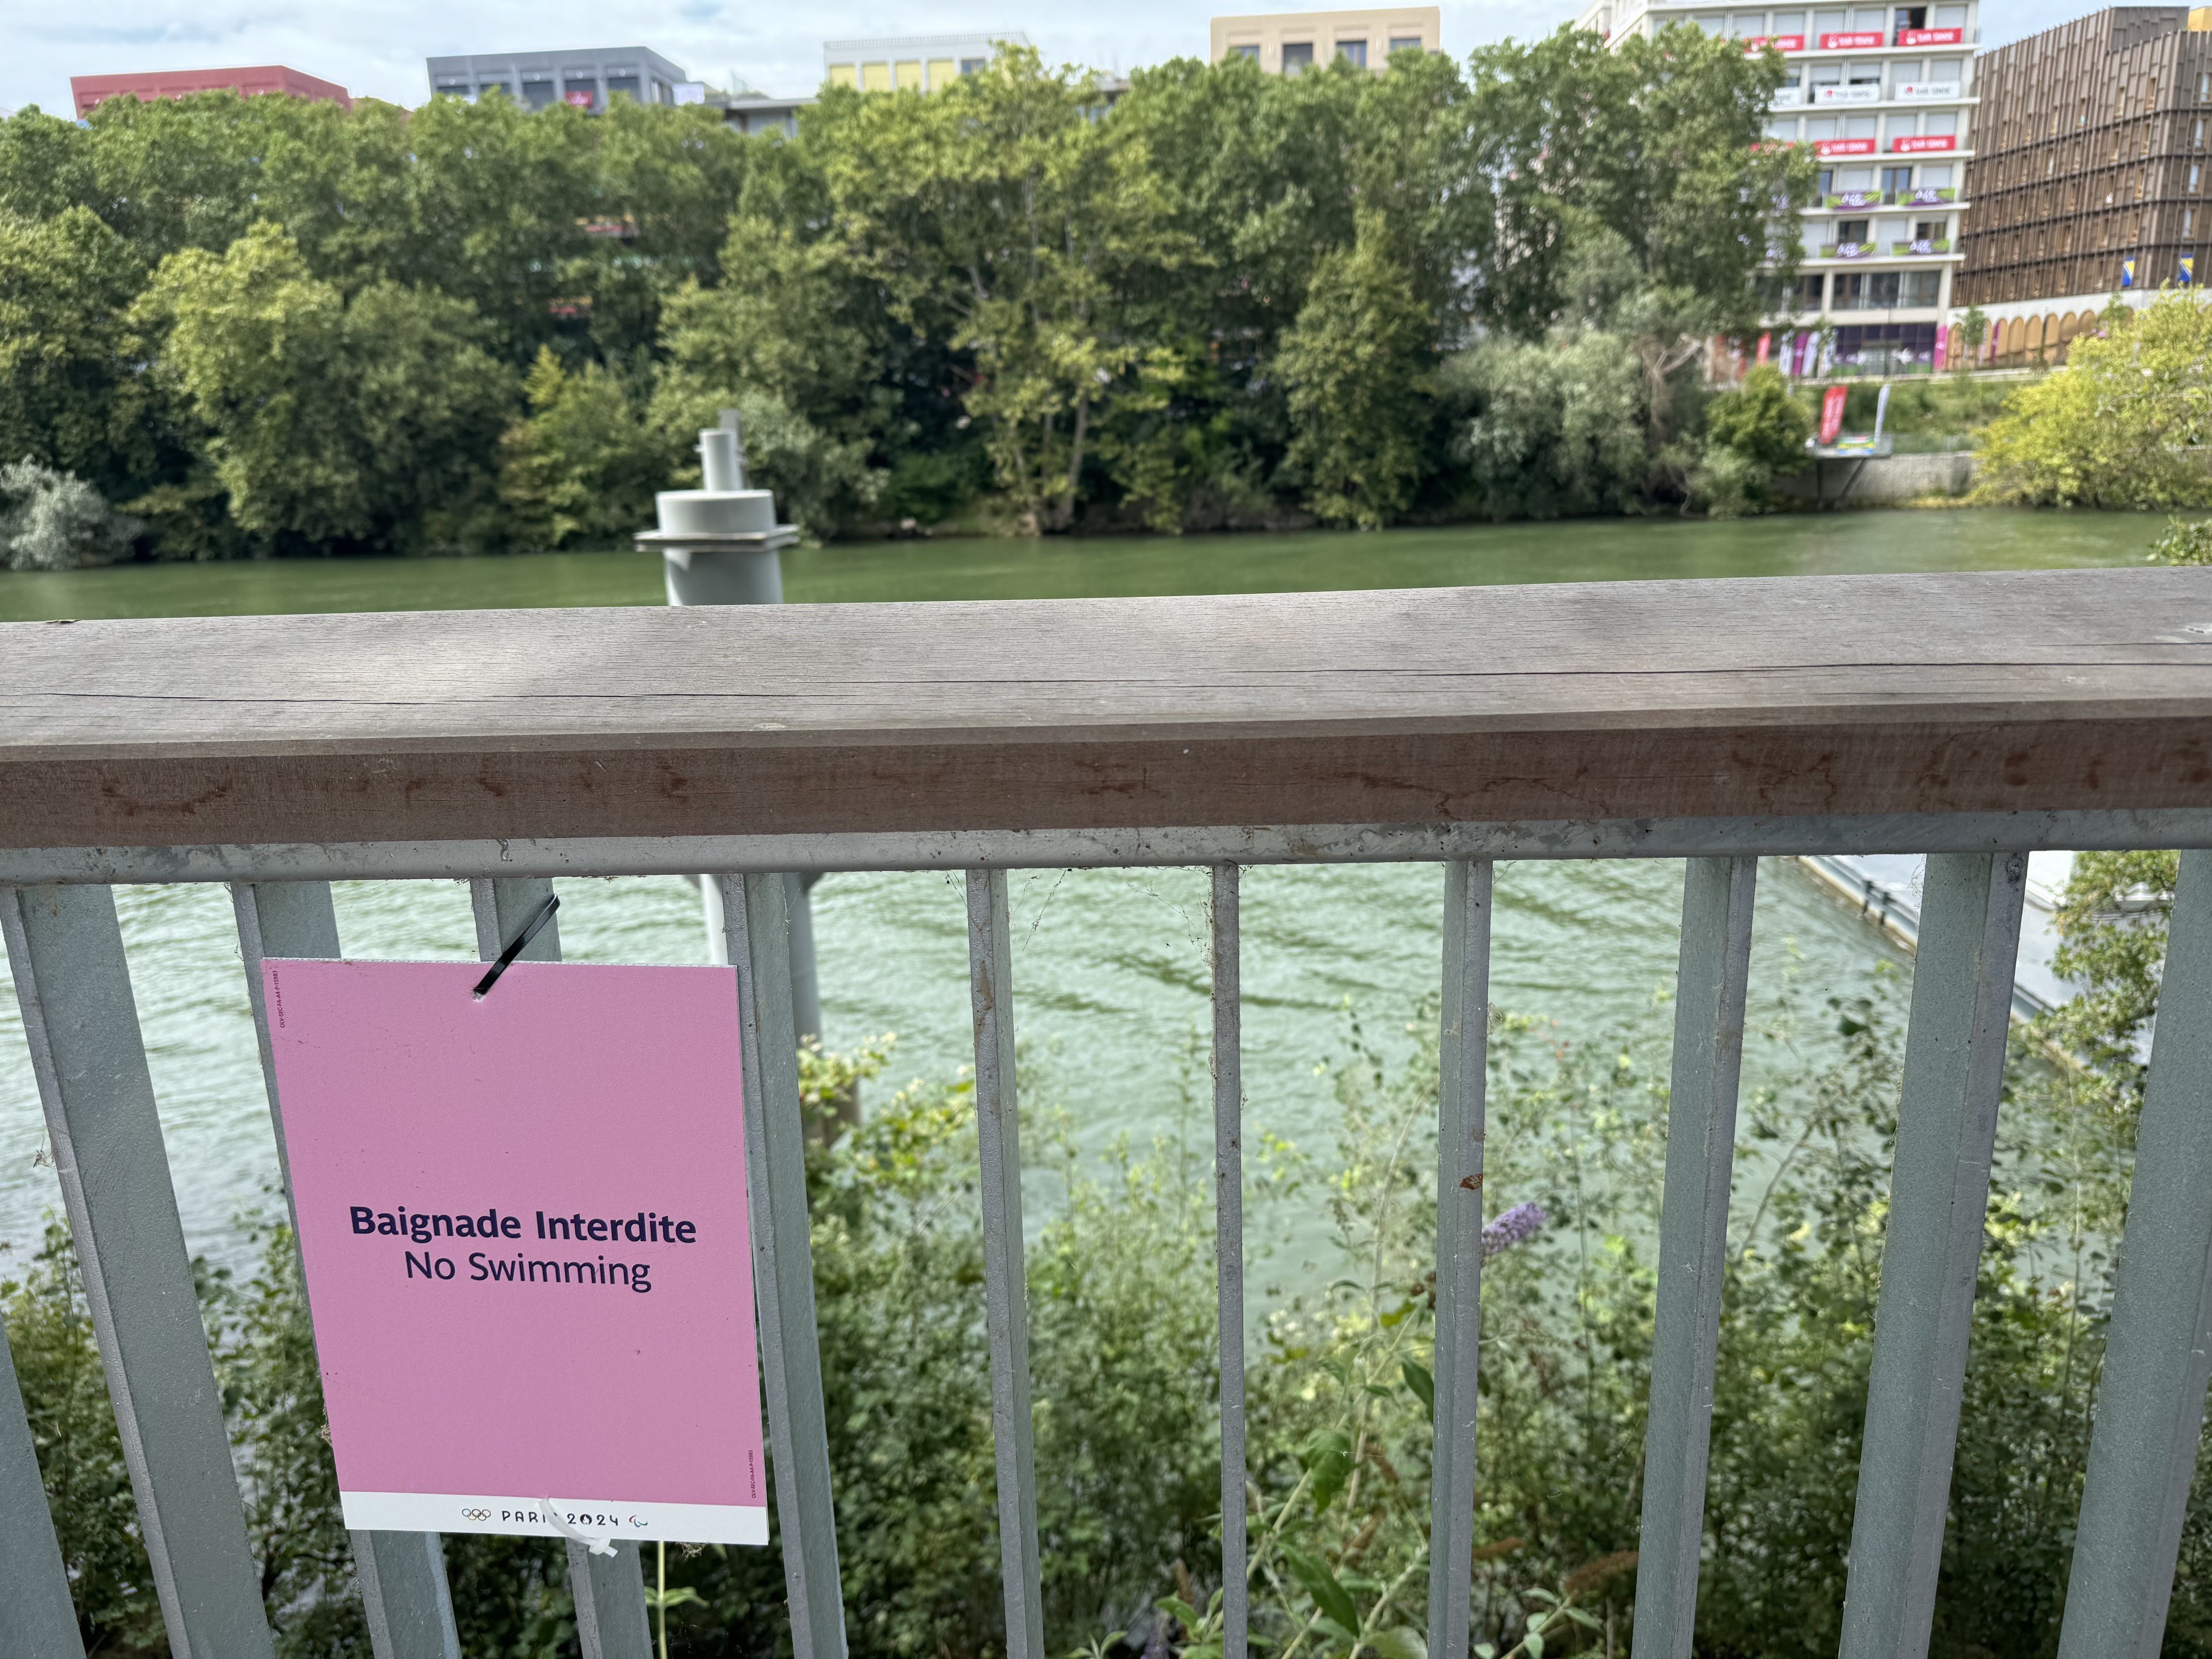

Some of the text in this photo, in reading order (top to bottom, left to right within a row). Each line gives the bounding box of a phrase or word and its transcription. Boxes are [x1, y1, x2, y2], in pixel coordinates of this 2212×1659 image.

[350, 1206, 696, 1243] Baignade Interdite
[405, 1251, 652, 1293] No Swimming
[502, 1511, 618, 1526] PARI 2024
